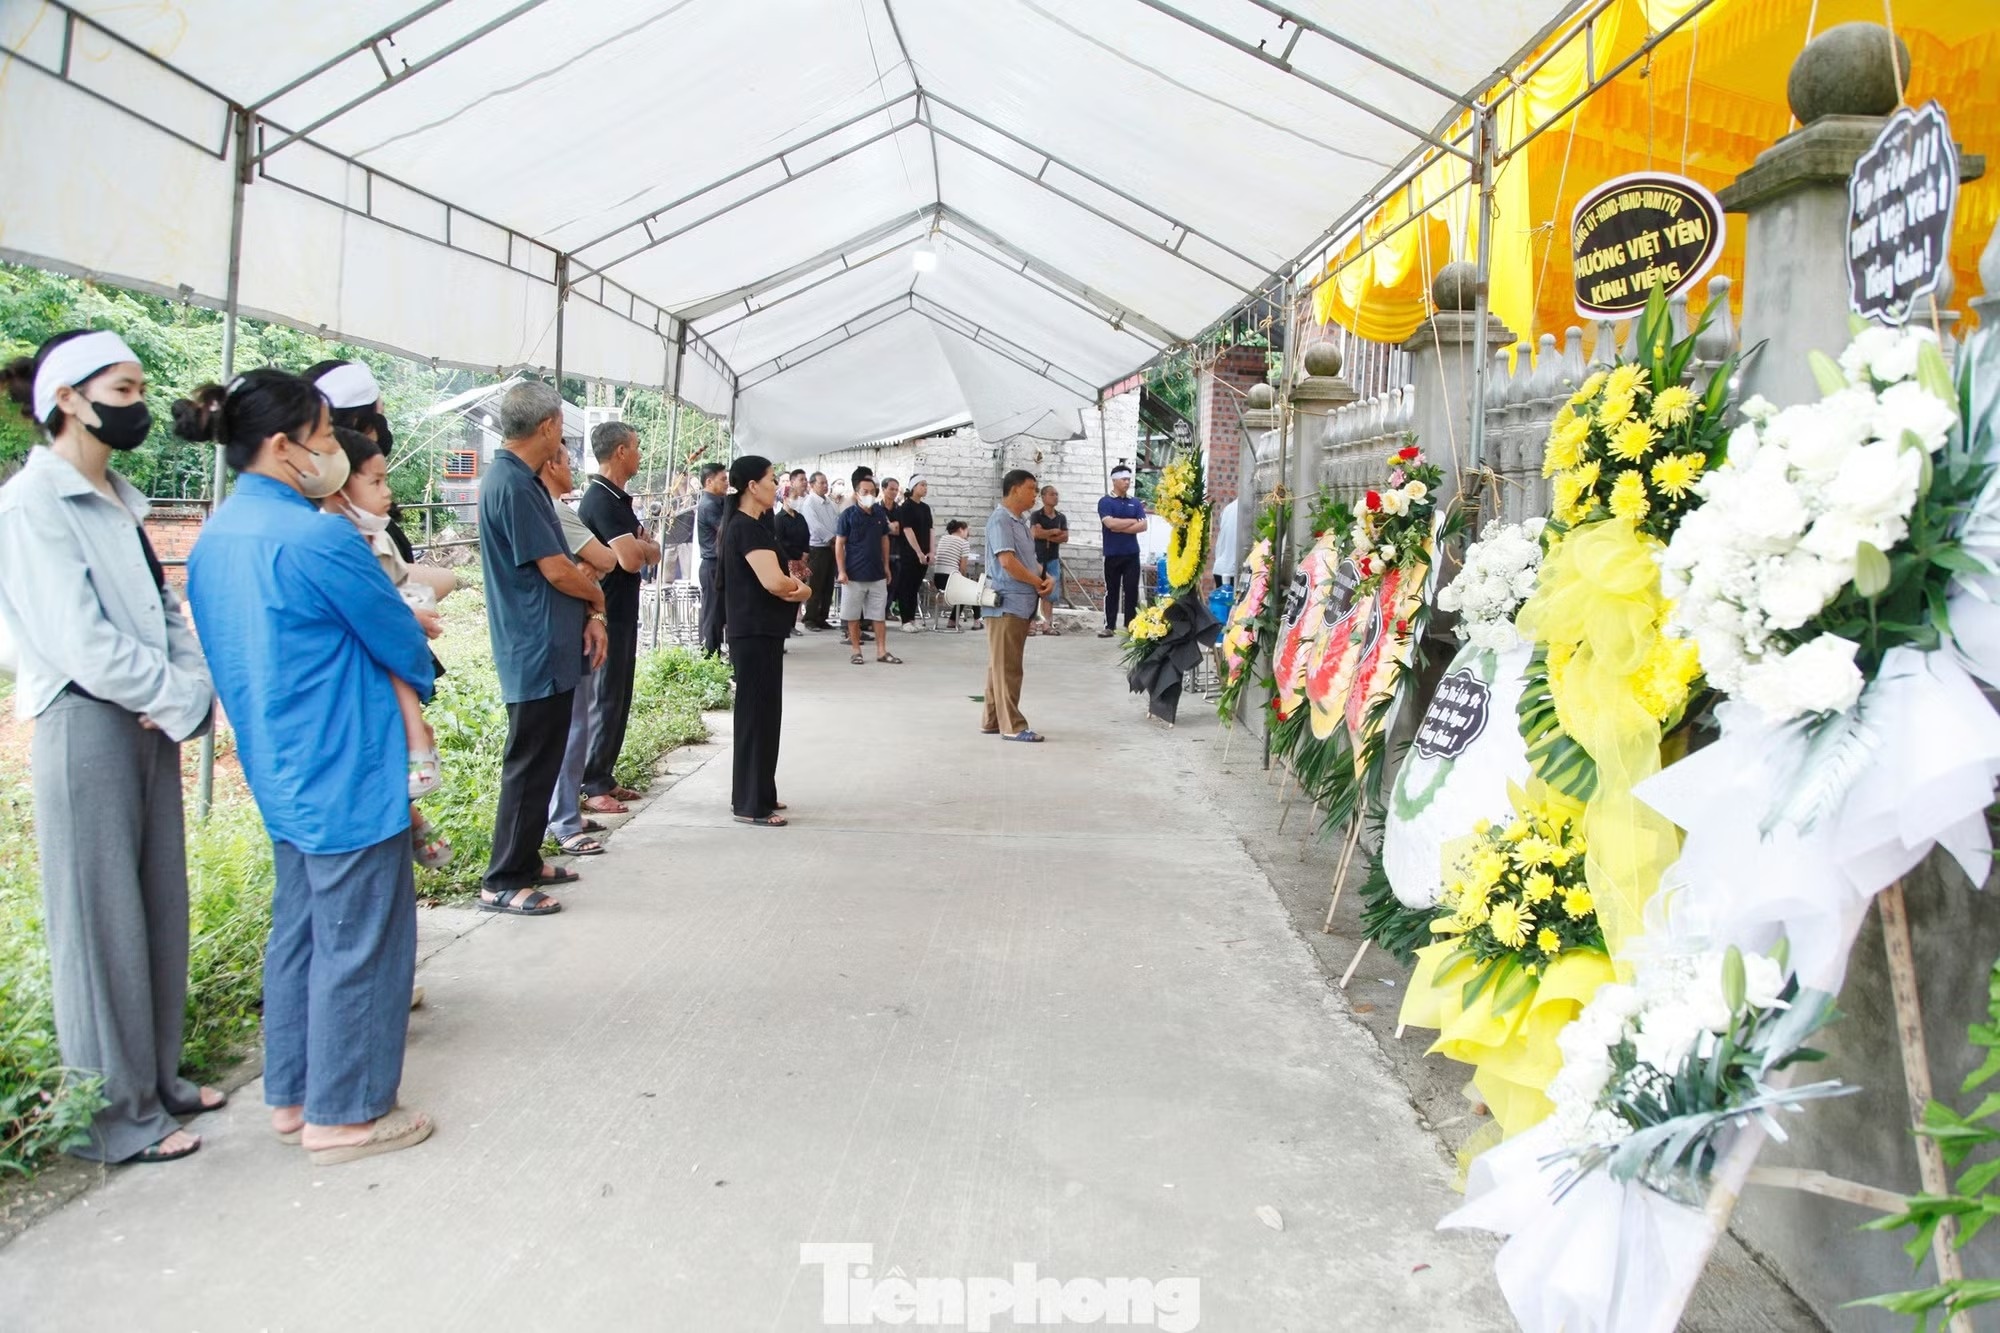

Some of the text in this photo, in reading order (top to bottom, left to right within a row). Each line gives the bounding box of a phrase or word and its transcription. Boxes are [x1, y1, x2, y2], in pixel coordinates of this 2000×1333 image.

[1575, 218, 1704, 280] PHƯỜNG VIỆT YÊN
[1590, 261, 1681, 304] KÍNH VIẾNG
